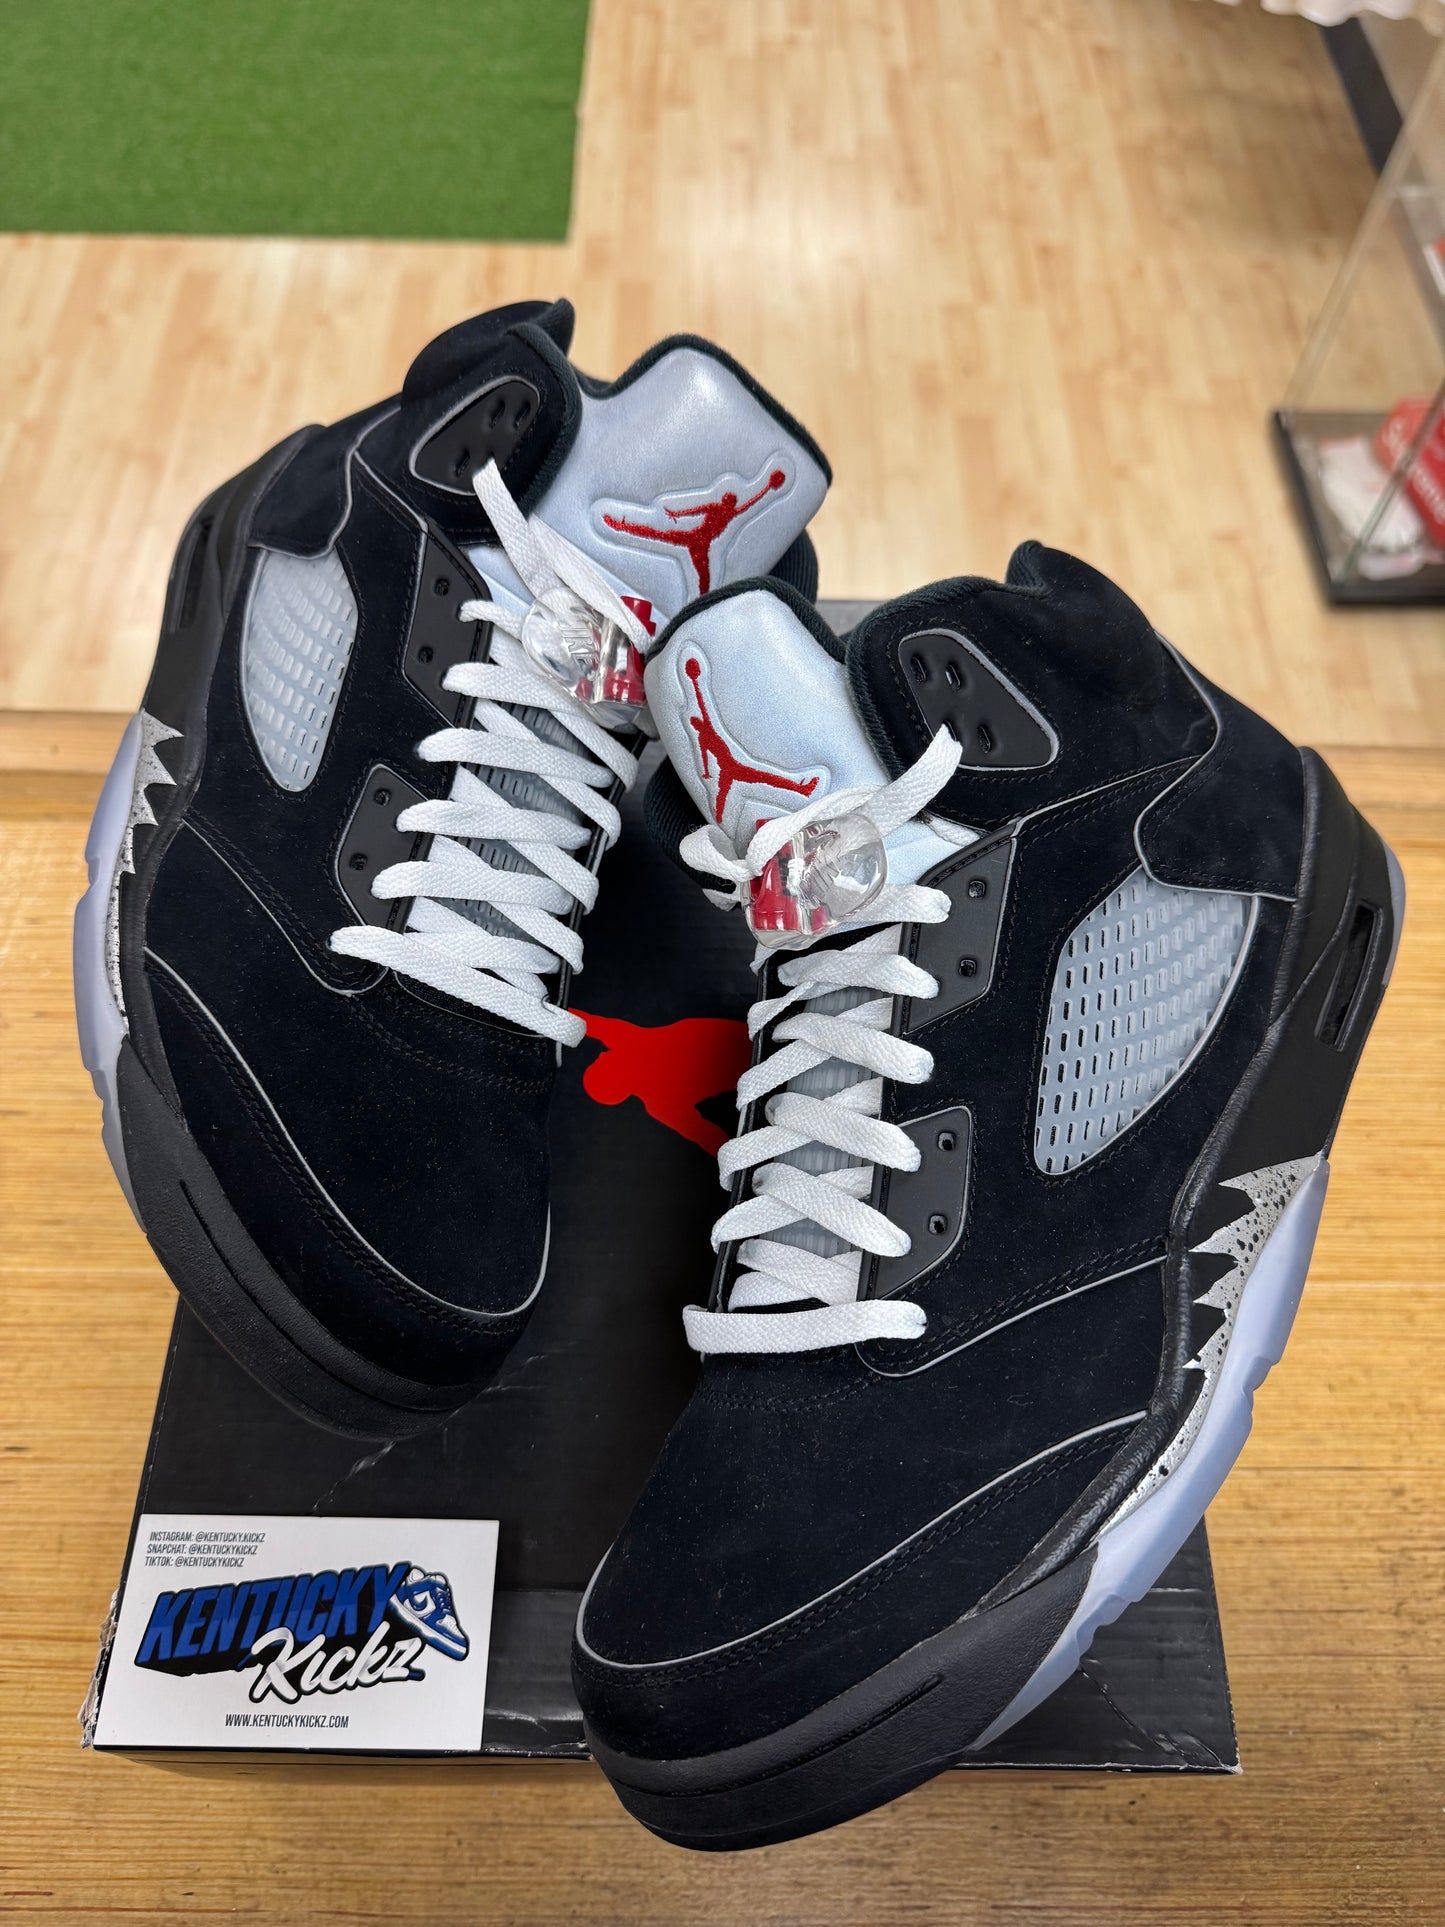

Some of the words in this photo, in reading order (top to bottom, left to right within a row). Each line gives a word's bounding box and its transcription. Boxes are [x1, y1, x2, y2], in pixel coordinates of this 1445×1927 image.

[150, 1531, 194, 1542] INSTAGRAM:
[195, 1531, 266, 1543] @KENTUCKY.KICKZ
[147, 1543, 187, 1554] SNAPCHAT:
[188, 1544, 258, 1555] @KENTUCKYKICKZ
[145, 1556, 173, 1567] TIKTOK:
[175, 1556, 245, 1568] @KENTUCKYKICKZ
[136, 1562, 411, 1667] KENTUCKY
[250, 1620, 423, 1702] Kickz
[225, 1713, 350, 1729] WWW.KENTUCKYKICKZ.COM
